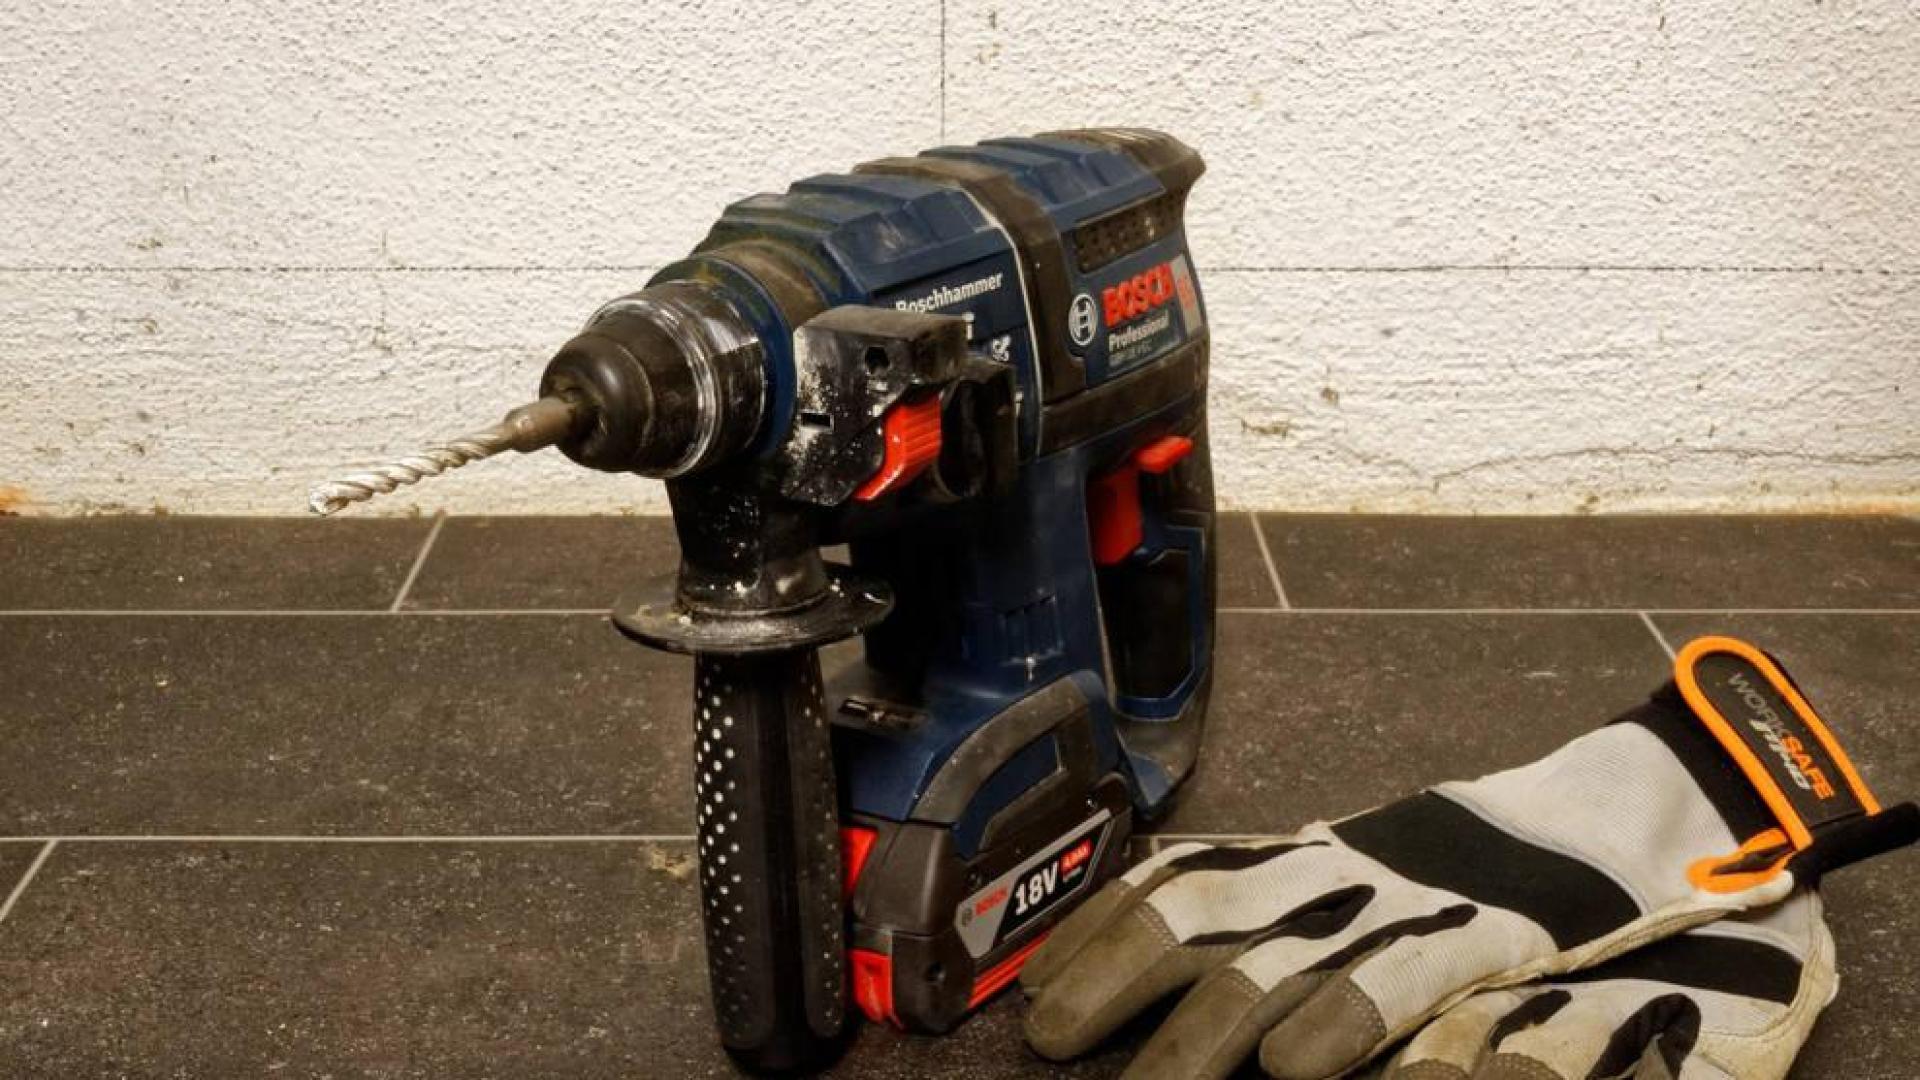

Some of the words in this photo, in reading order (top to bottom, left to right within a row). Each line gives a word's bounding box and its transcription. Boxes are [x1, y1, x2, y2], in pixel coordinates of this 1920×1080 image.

[1103, 262, 1174, 329] BOSCH
[1109, 309, 1169, 352] Professional
[1015, 860, 1059, 915] 18V
